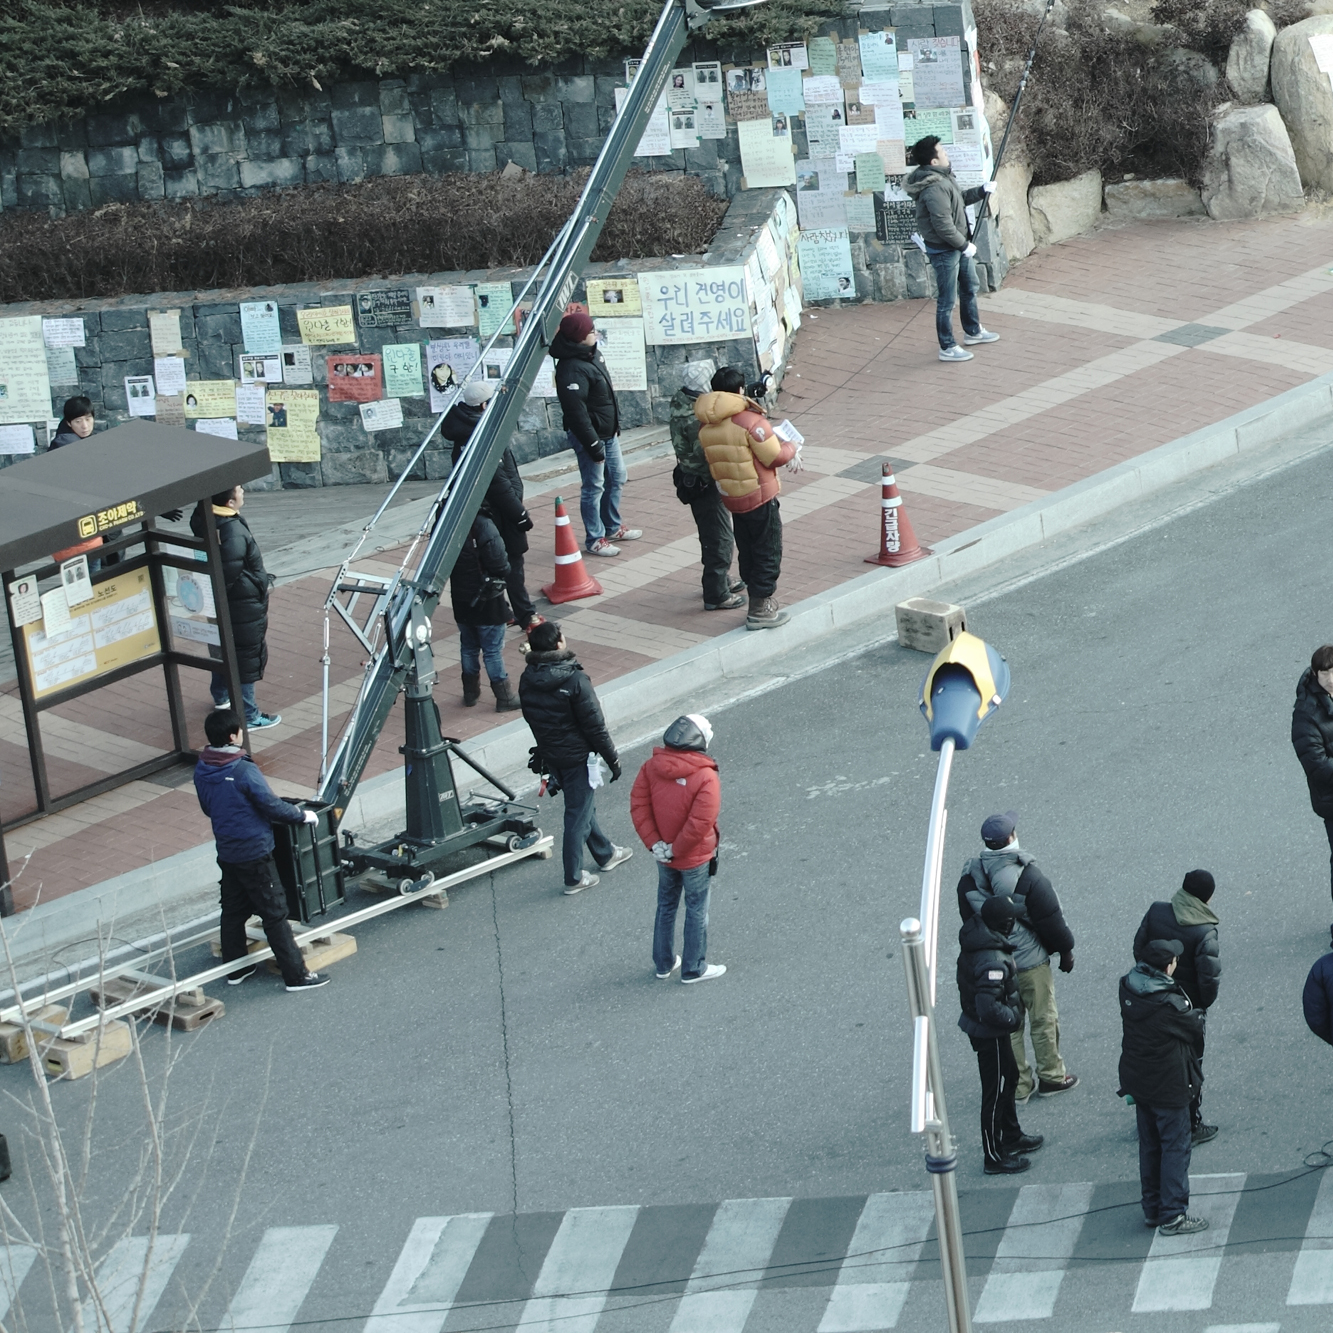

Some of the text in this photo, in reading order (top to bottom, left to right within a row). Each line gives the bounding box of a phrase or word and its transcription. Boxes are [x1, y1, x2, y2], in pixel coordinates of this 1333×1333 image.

[657, 282, 689, 311] 우리
[659, 307, 747, 337] 살려주세요
[97, 500, 137, 526] 조아제약
